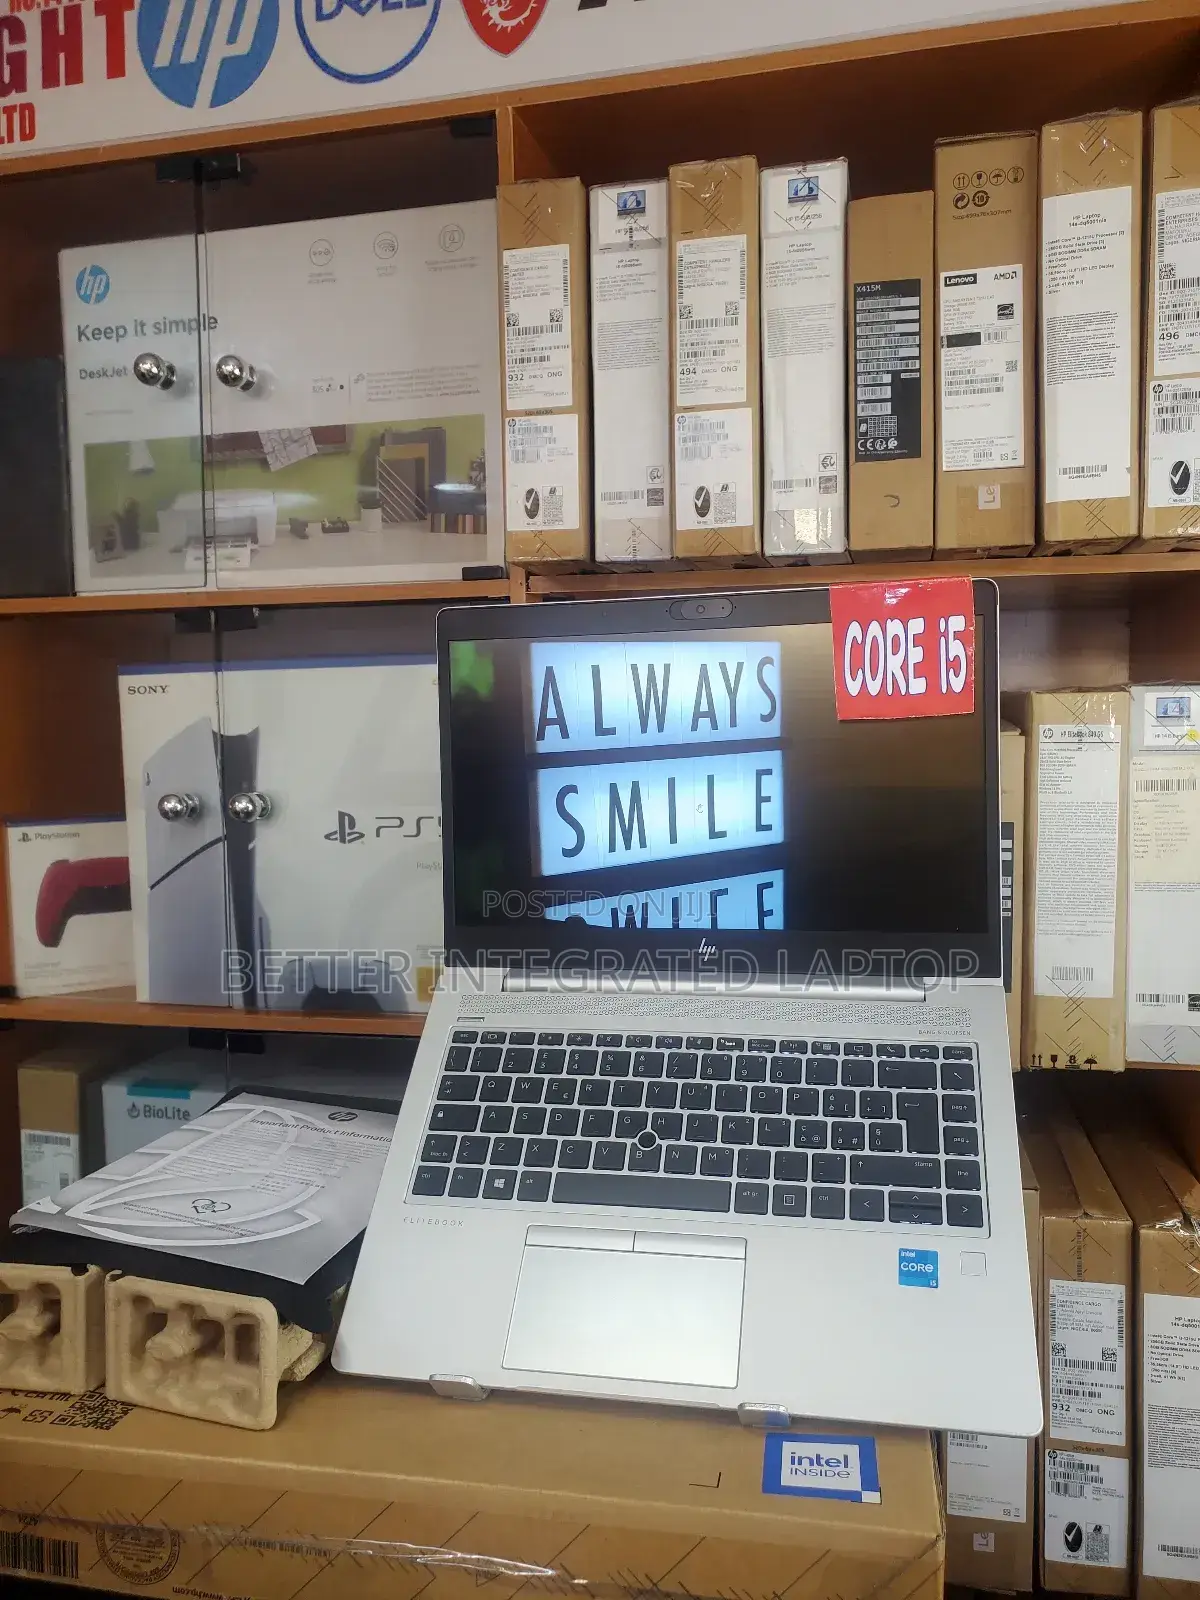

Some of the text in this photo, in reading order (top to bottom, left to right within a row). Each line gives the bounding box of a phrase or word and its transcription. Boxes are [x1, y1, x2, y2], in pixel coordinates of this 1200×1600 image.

[946, 276, 975, 285] Lenovo
[993, 271, 1012, 281] AMD
[78, 265, 108, 305] hp
[856, 284, 882, 293] X415M
[77, 313, 219, 343] Keep it simple
[1158, 331, 1180, 341] 496
[79, 365, 129, 380] DeskJet
[507, 373, 525, 382] 932
[547, 370, 563, 378] ONG
[679, 367, 697, 376] 494
[721, 365, 738, 373] ONG
[844, 614, 967, 697] CORE i5
[127, 684, 169, 695] SONY
[536, 656, 777, 742] ALWAYS
[555, 768, 773, 858] SMILE
[34, 831, 80, 841] PlayStation
[698, 937, 716, 962] hp
[706, 1067, 713, 1075] 8
[487, 1080, 496, 1088] Q
[585, 1084, 593, 1092] R
[619, 1085, 626, 1093] T
[653, 1086, 661, 1094] Y
[687, 1088, 695, 1096] U
[758, 1091, 766, 1099] O
[793, 1093, 800, 1101] P
[143, 1103, 191, 1121] BioLite
[488, 1111, 771, 1131] A S D F G H J K L
[250, 1118, 393, 1143] Important Product Informatio
[497, 1143, 505, 1151] Z
[531, 1144, 539, 1152] X
[566, 1146, 574, 1154] C
[602, 1147, 609, 1155] V
[635, 1151, 643, 1159] B
[671, 1151, 680, 1159] N
[900, 1250, 916, 1258] intel
[1051, 1402, 1071, 1412] 932
[1097, 1408, 1115, 1416] ONG
[789, 1452, 849, 1469] intel
